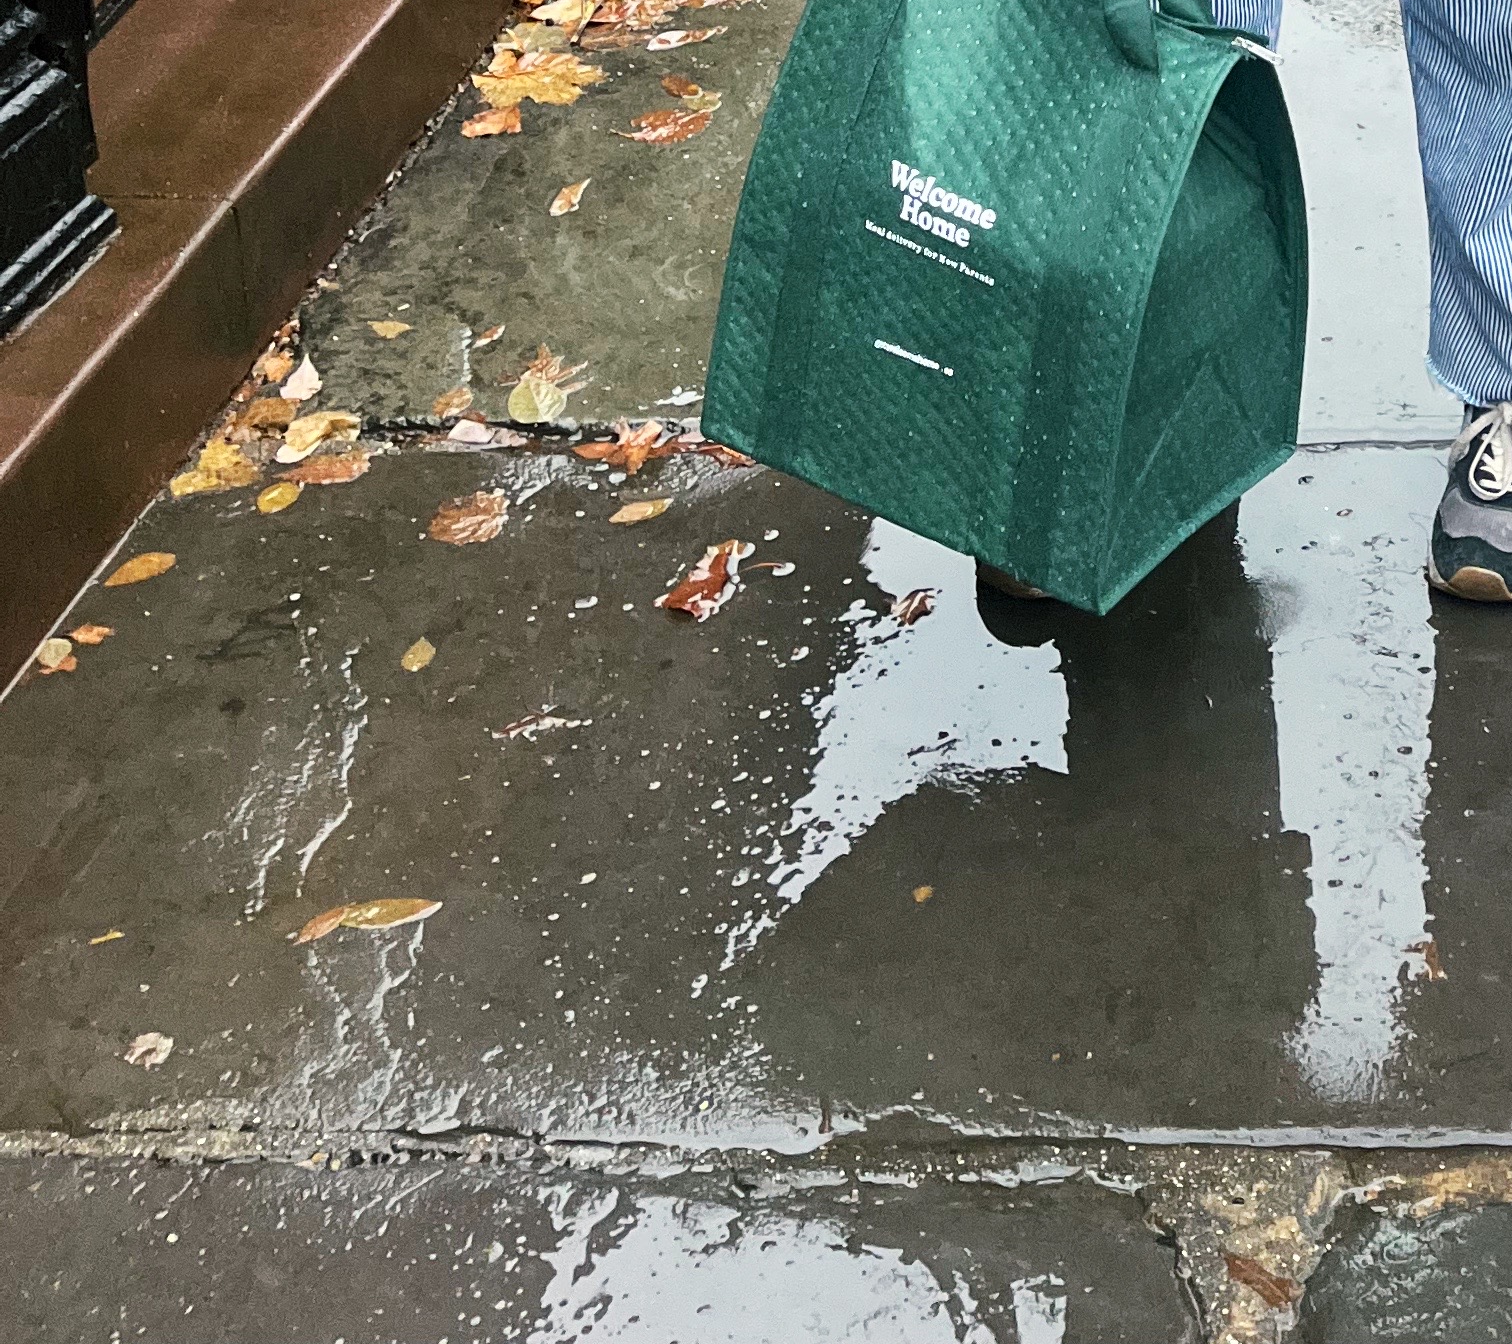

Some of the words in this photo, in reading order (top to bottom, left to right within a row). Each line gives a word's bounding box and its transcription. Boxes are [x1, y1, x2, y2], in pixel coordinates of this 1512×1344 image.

[892, 160, 996, 229] Welcome
[900, 195, 970, 248] Home
[923, 247, 938, 260] for
[959, 262, 995, 286] Parents
